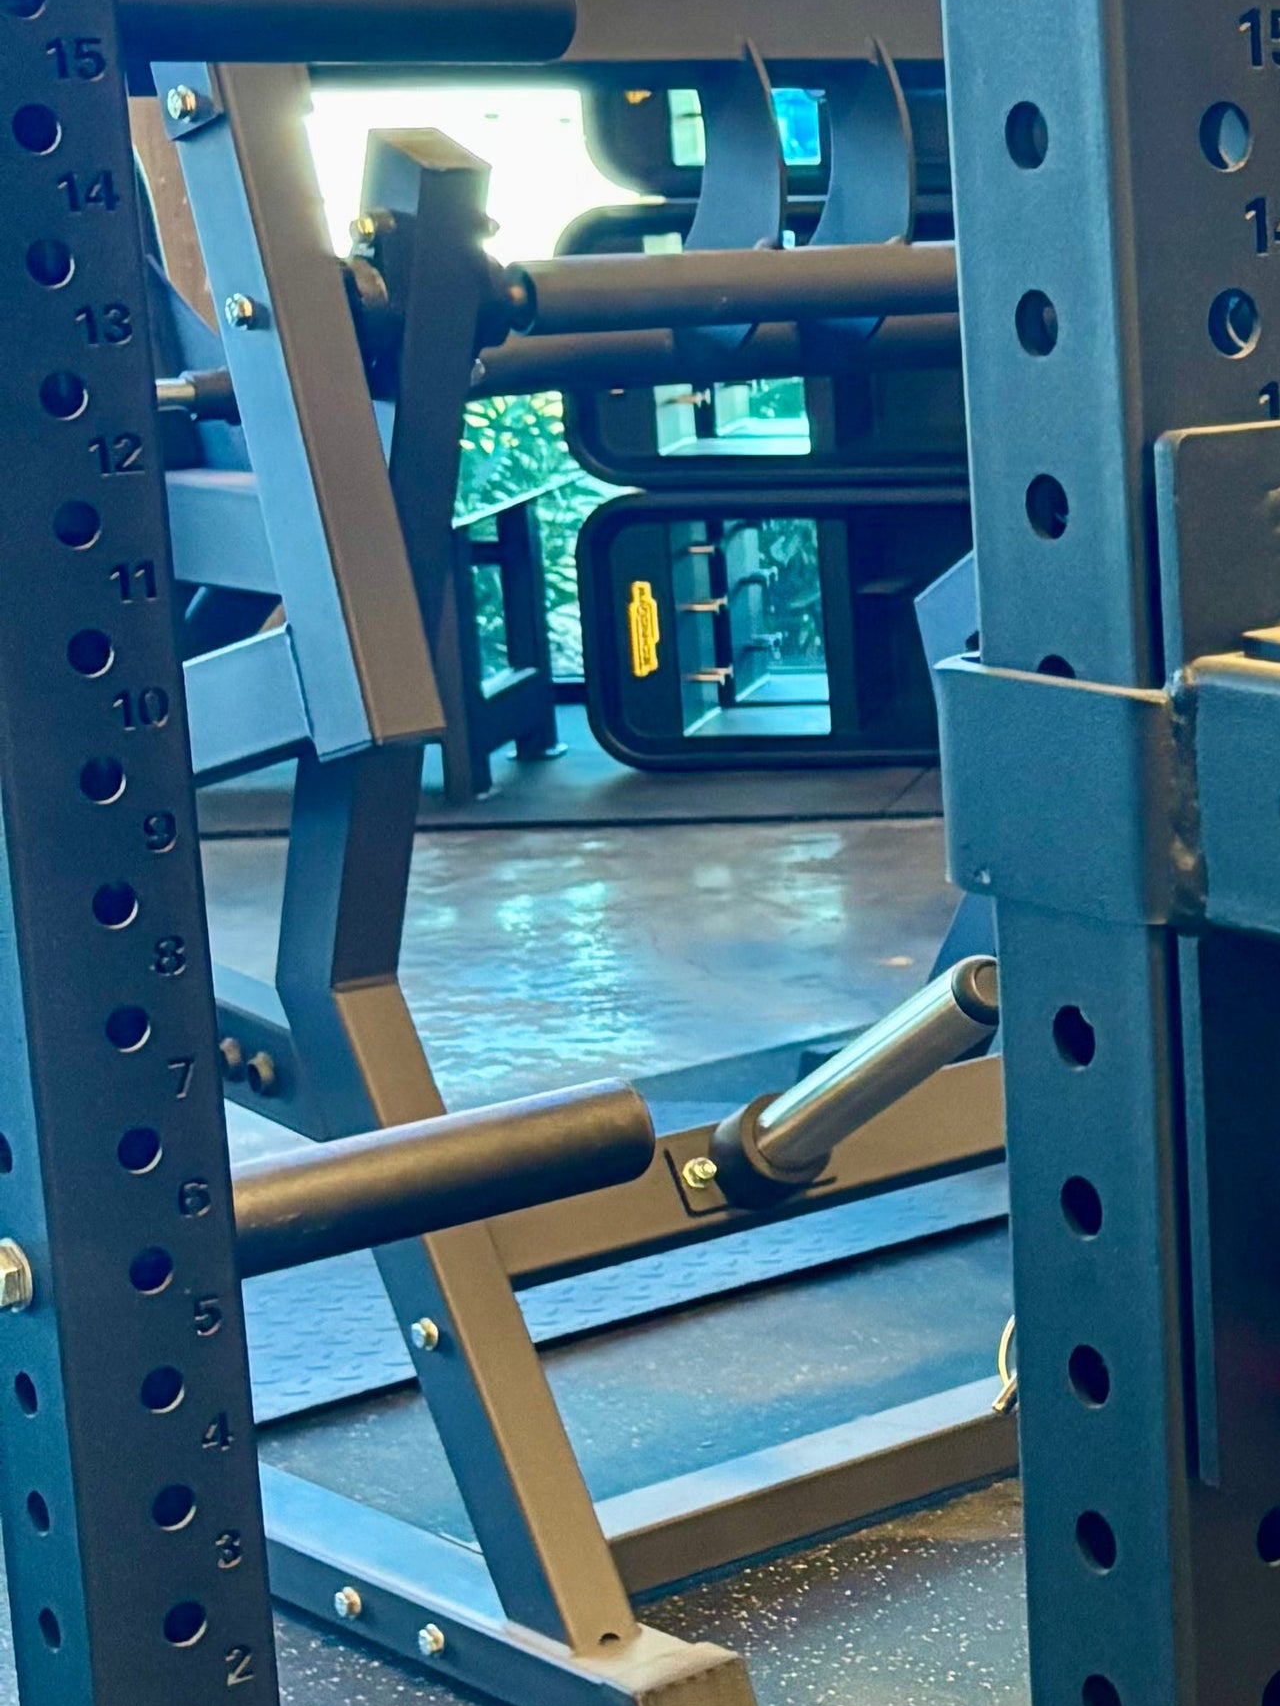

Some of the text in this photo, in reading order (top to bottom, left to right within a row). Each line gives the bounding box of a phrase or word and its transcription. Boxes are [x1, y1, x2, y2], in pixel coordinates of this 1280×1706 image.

[45, 38, 108, 82] 15
[56, 169, 120, 213] 14
[75, 303, 134, 347] 13
[88, 430, 146, 476] 12
[109, 558, 159, 604] 11
[114, 685, 169, 731] 10
[142, 810, 177, 853] 9
[150, 935, 187, 977] 8
[168, 1055, 194, 1099] 7
[178, 1179, 212, 1217] 6
[193, 1297, 222, 1336] 5
[203, 1411, 234, 1451] 4
[215, 1529, 243, 1569] 3
[226, 1644, 254, 1686] 2
